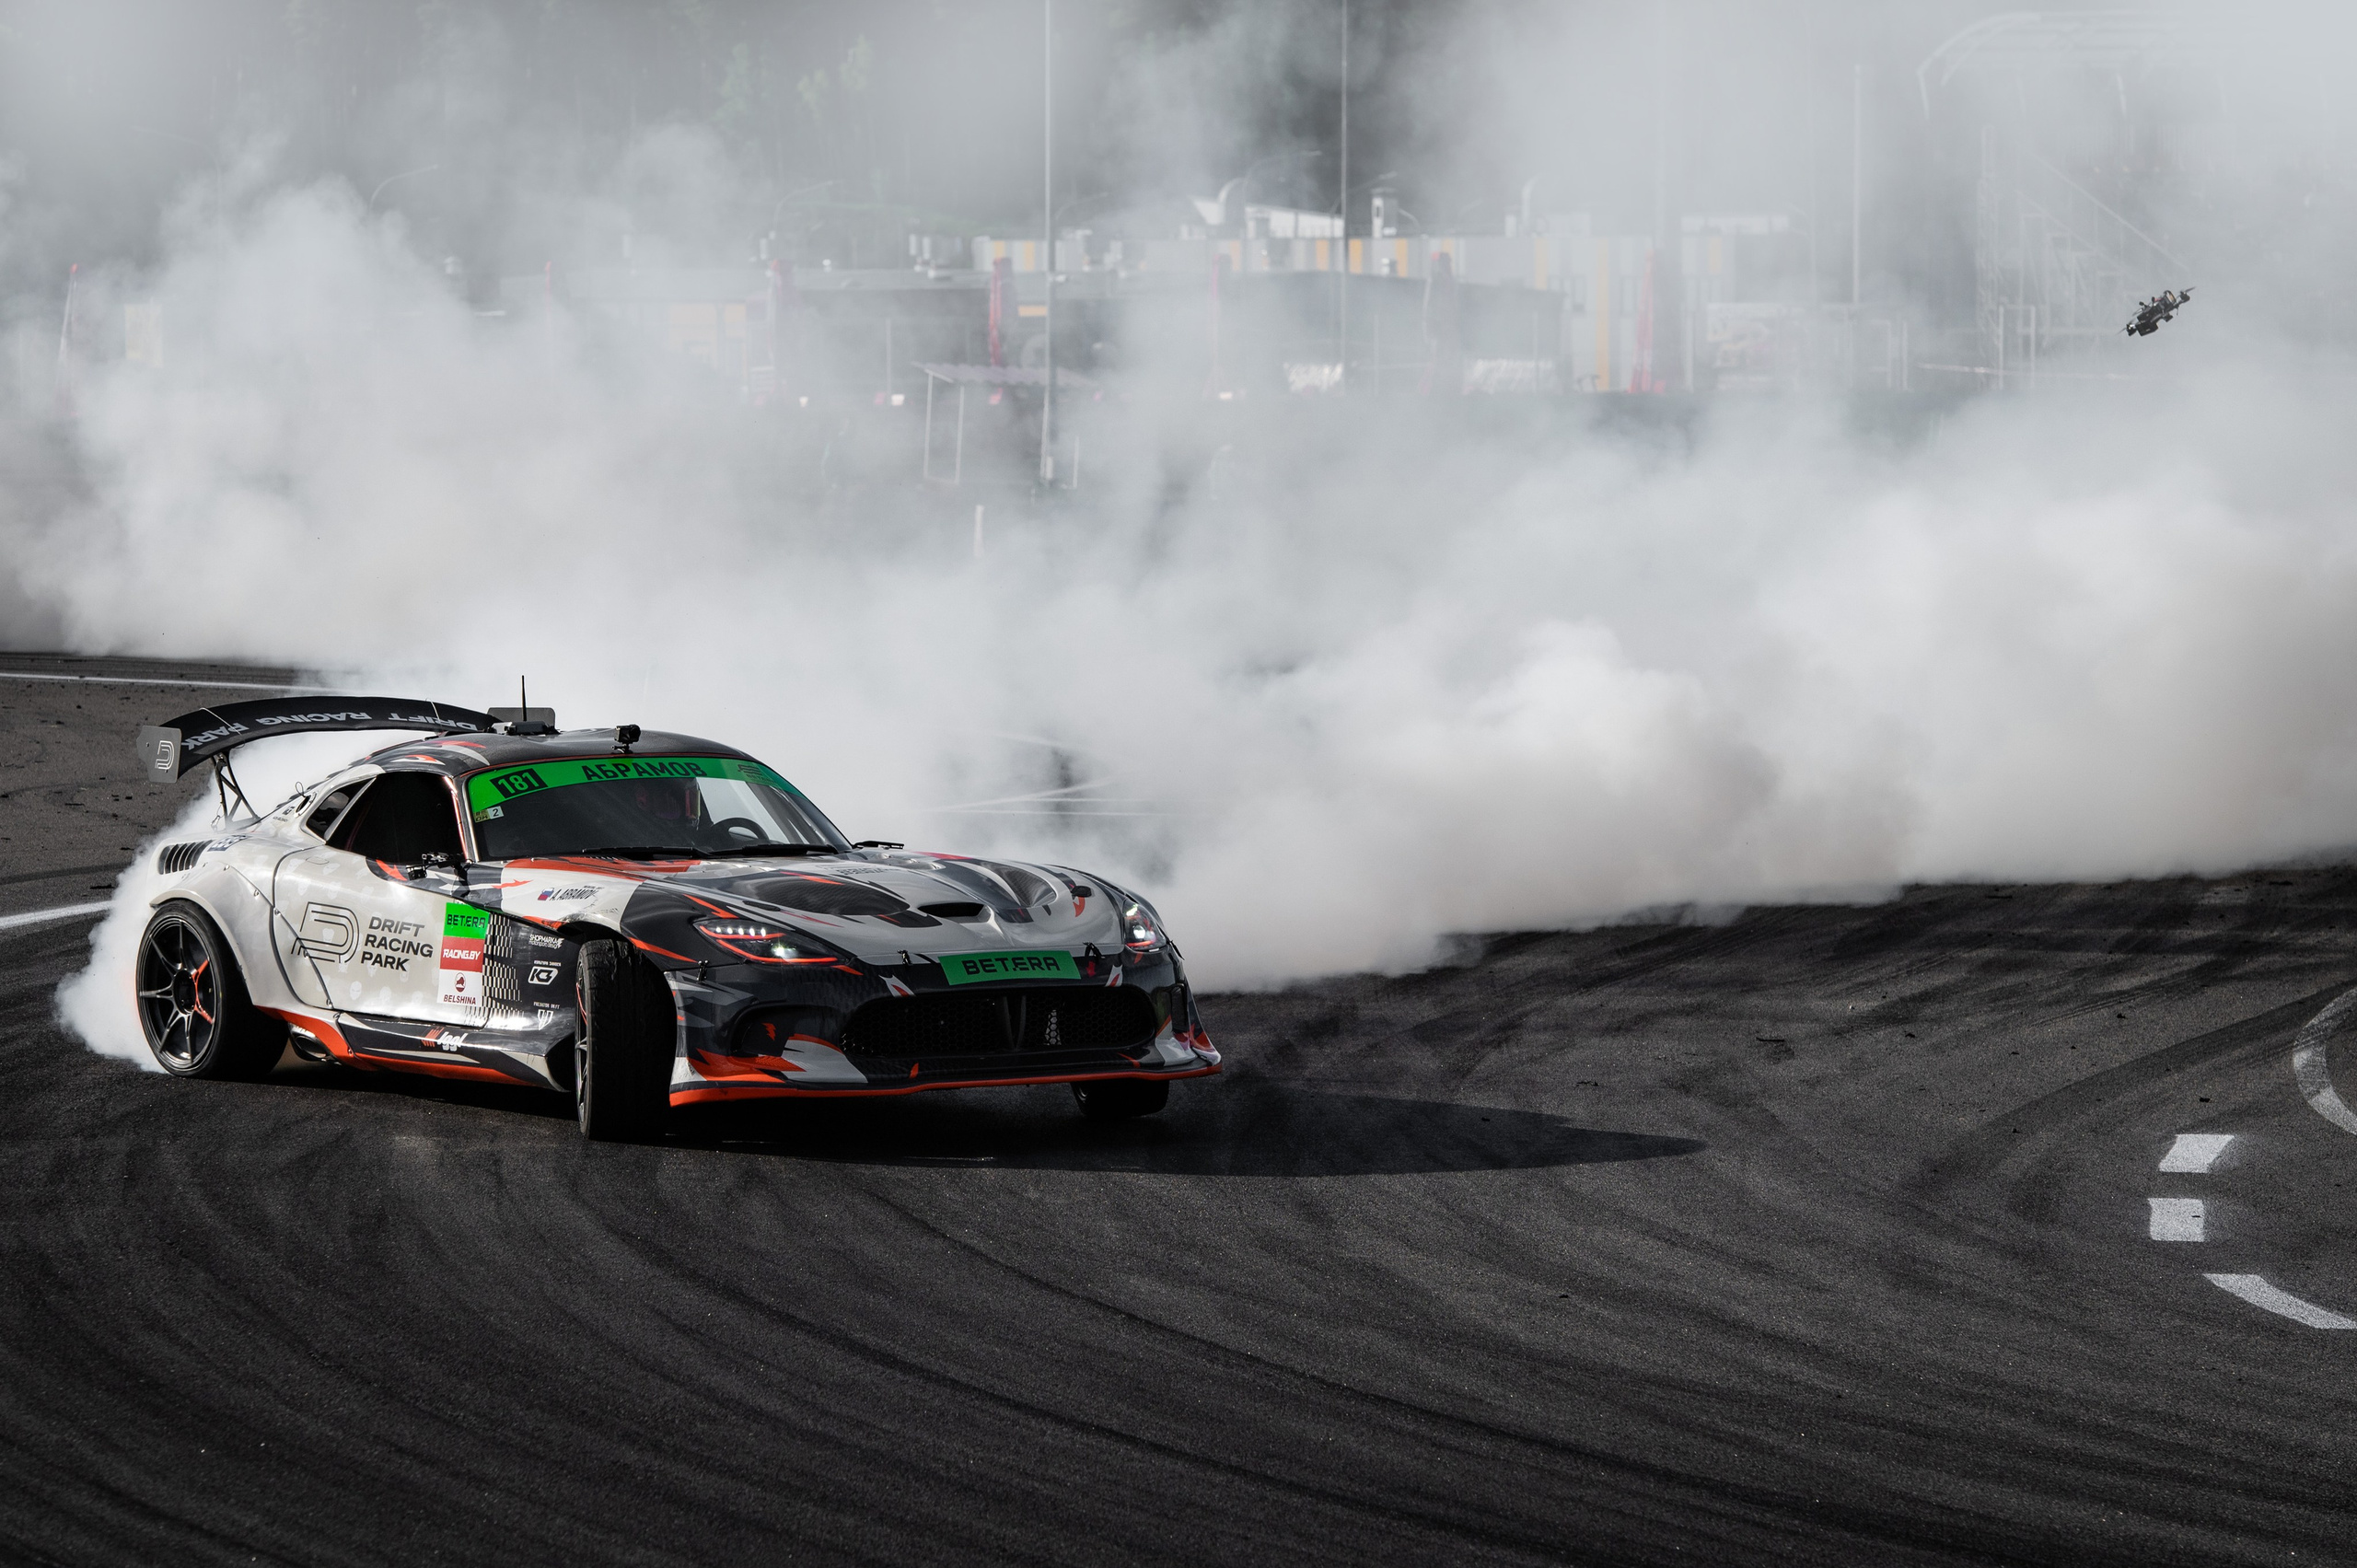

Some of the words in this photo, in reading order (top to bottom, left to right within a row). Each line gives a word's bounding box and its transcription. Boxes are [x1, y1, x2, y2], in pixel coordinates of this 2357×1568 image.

[255, 712, 373, 726] RACING
[389, 713, 478, 731] DRIFT
[181, 723, 250, 750] PARK
[581, 761, 708, 781] АБРАМОВ
[498, 772, 540, 795] 181
[493, 807, 500, 818] 2
[368, 916, 425, 937] DRIFT
[364, 934, 435, 958] RACING
[360, 950, 411, 972] PARK
[443, 994, 477, 1005] BELSHINA
